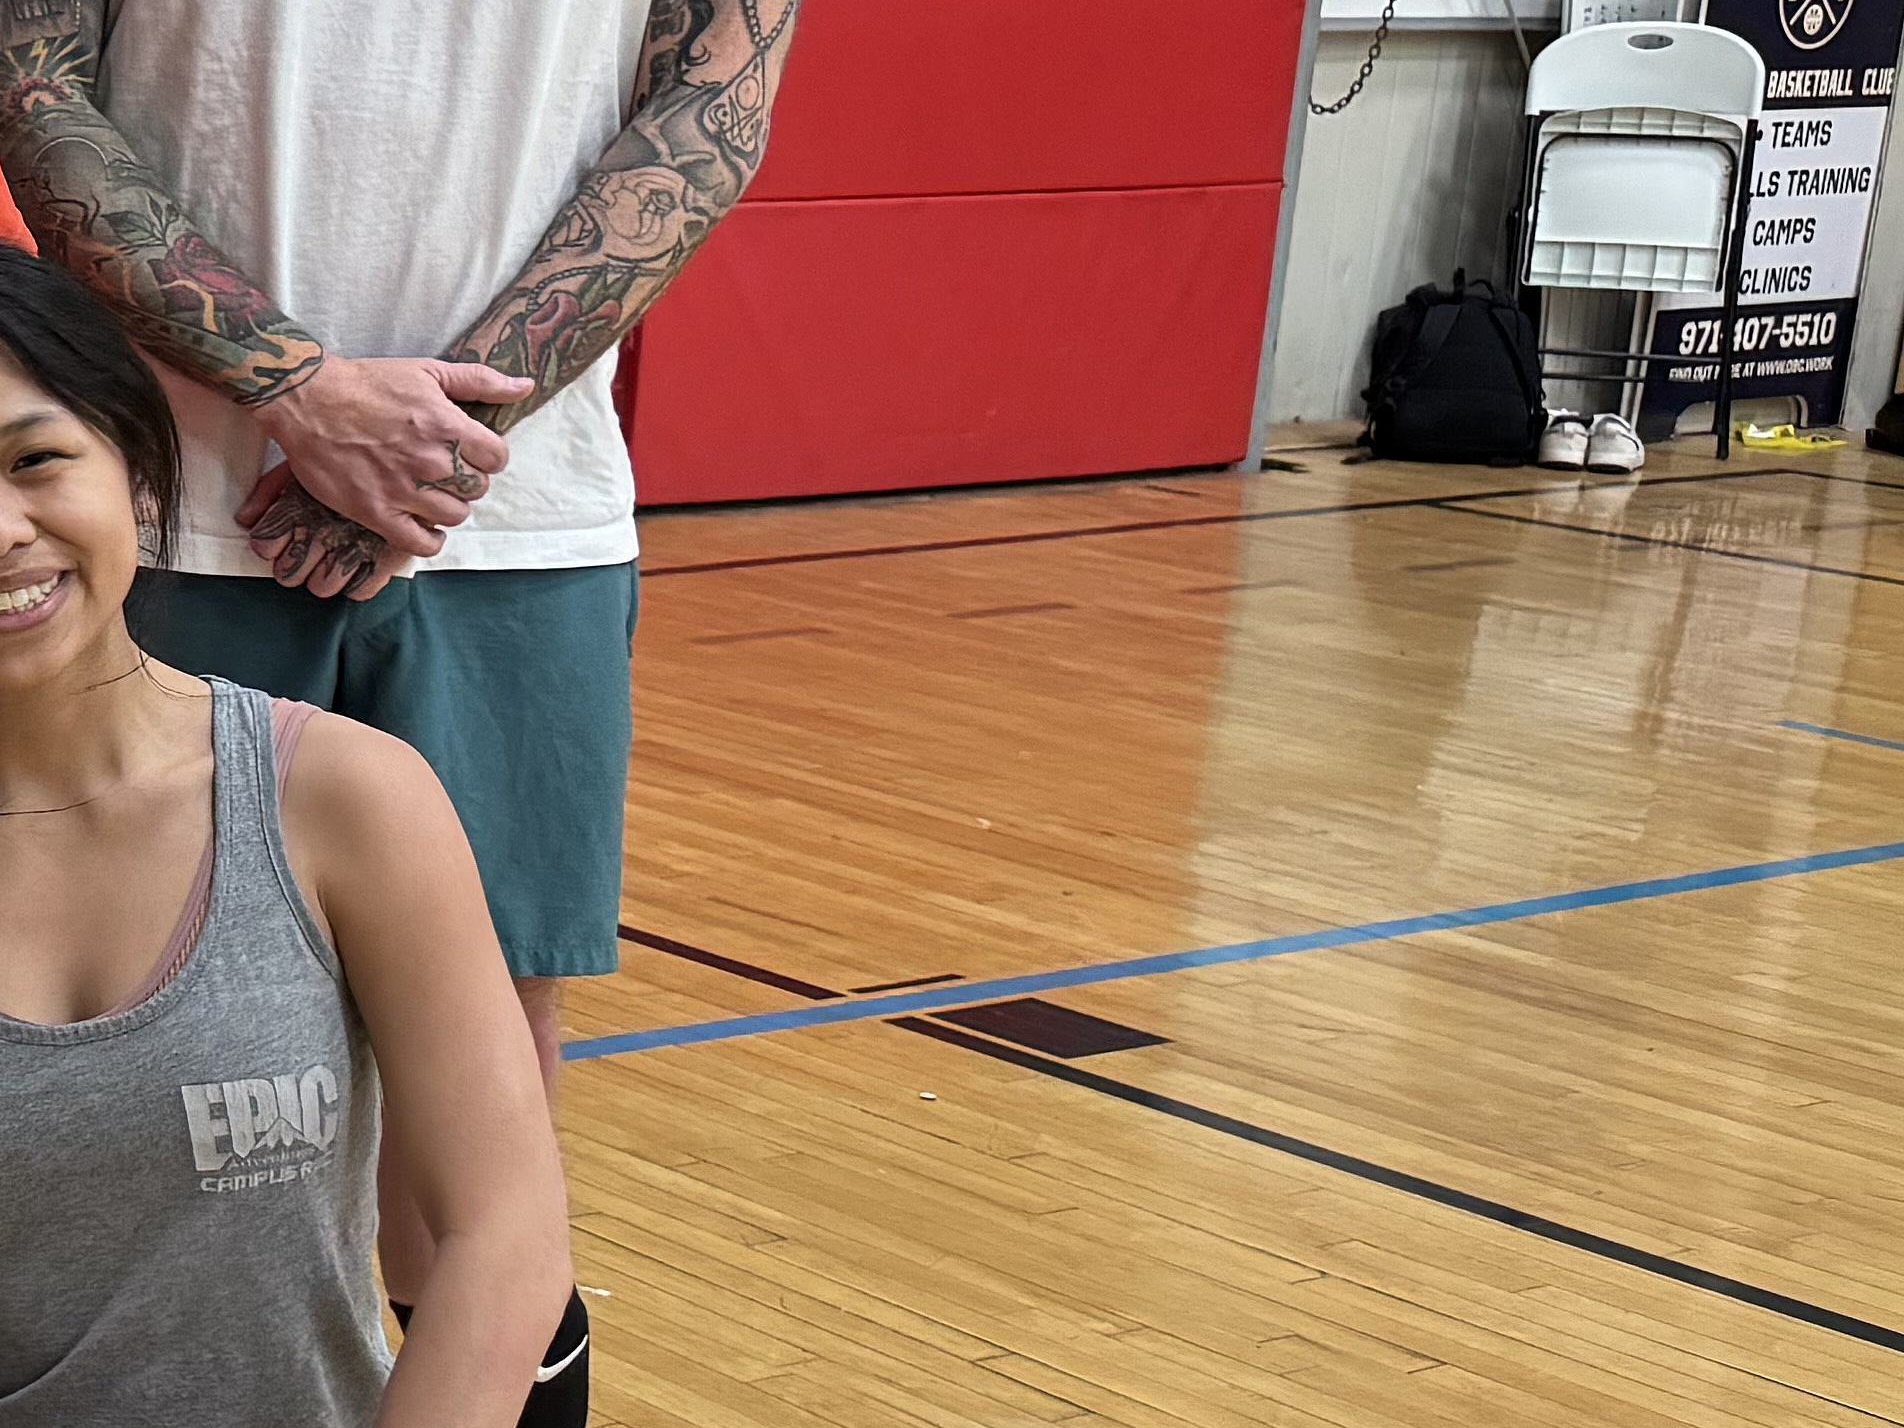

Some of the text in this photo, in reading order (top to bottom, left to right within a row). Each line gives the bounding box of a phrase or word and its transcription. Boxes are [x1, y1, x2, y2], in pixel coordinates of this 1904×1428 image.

[1766, 68, 1853, 99] BASKETBALL
[1772, 120, 1833, 149] TEAMS
[1787, 166, 1871, 197] TRAINING
[1752, 217, 1817, 246] CAMPS
[1738, 265, 1812, 295] CLINICS
[1742, 361, 1756, 378] AT
[180, 1065, 339, 1172] EPIC
